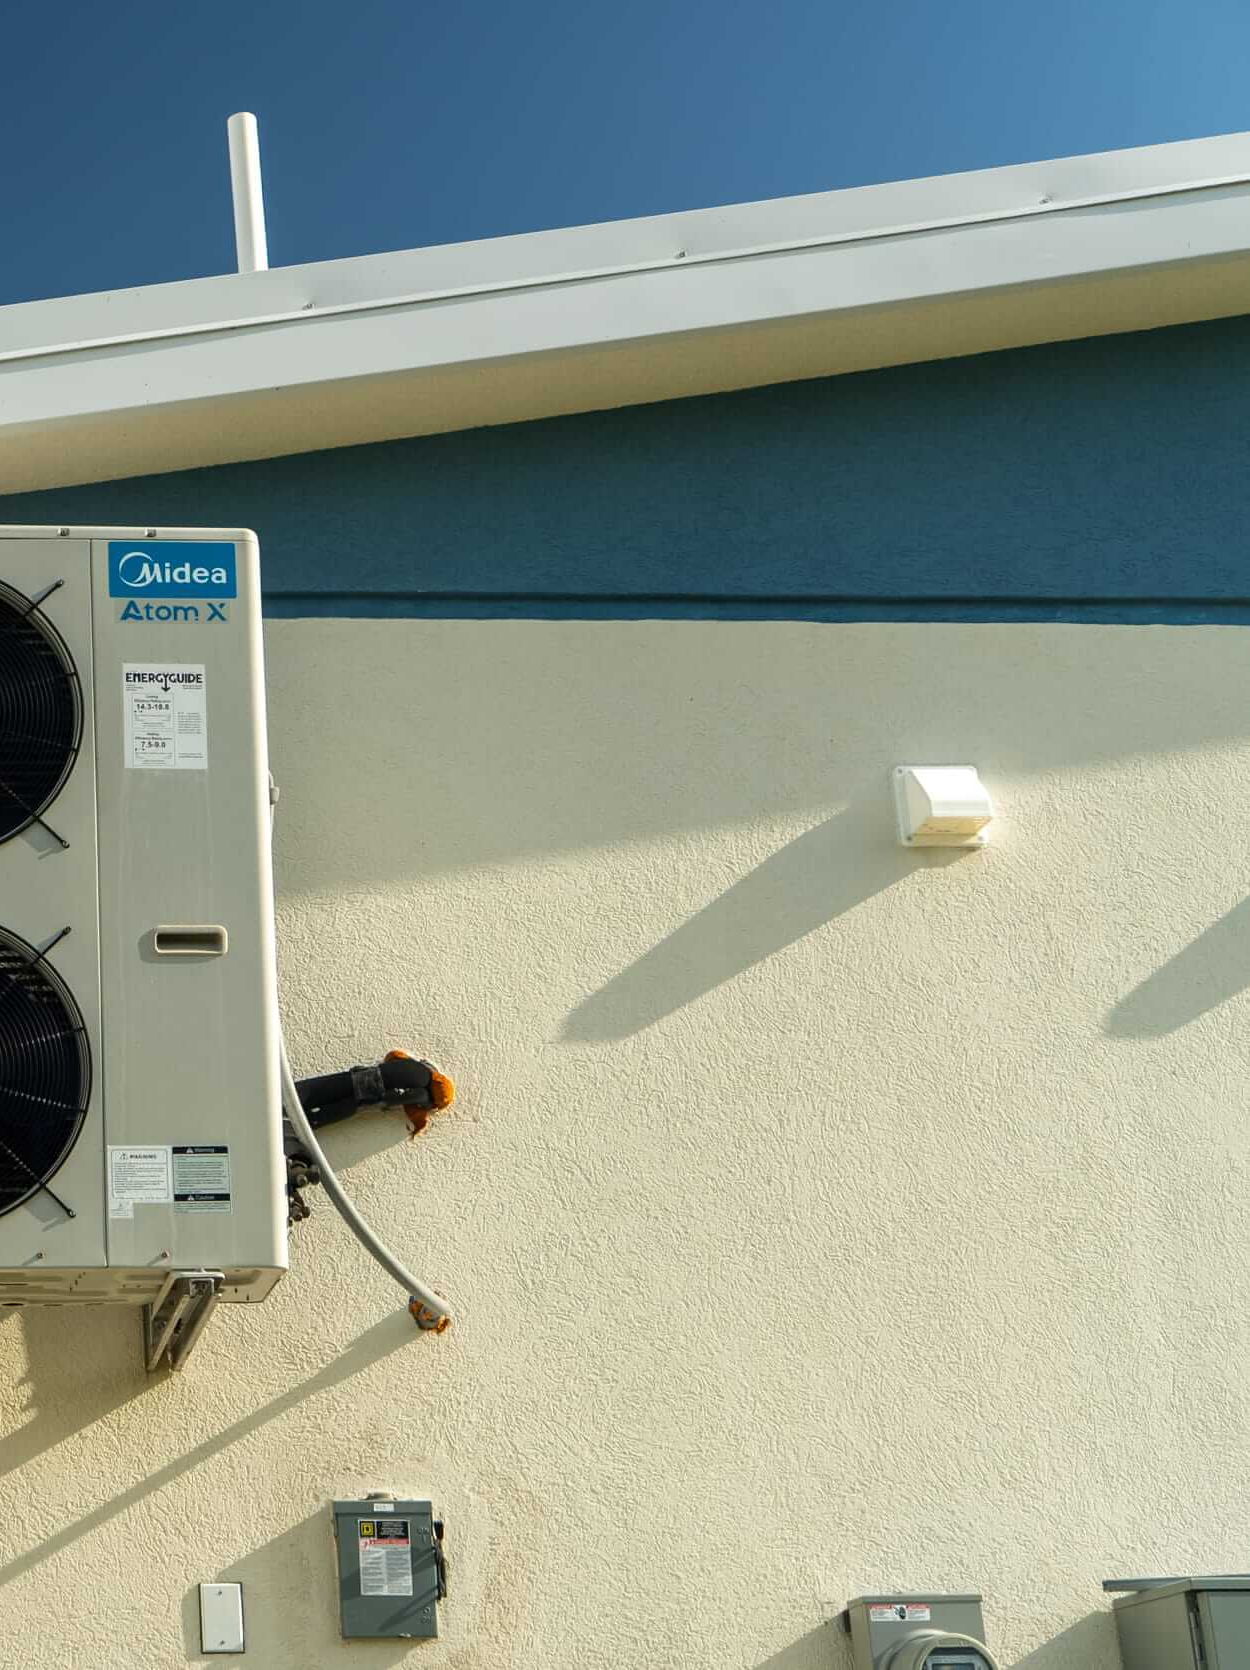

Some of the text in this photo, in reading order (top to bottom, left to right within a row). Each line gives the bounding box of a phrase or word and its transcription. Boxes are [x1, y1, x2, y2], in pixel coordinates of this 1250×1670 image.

[119, 552, 227, 587] Midea
[120, 600, 227, 621] Atom X
[125, 672, 204, 684] ENERGYGUIDE
